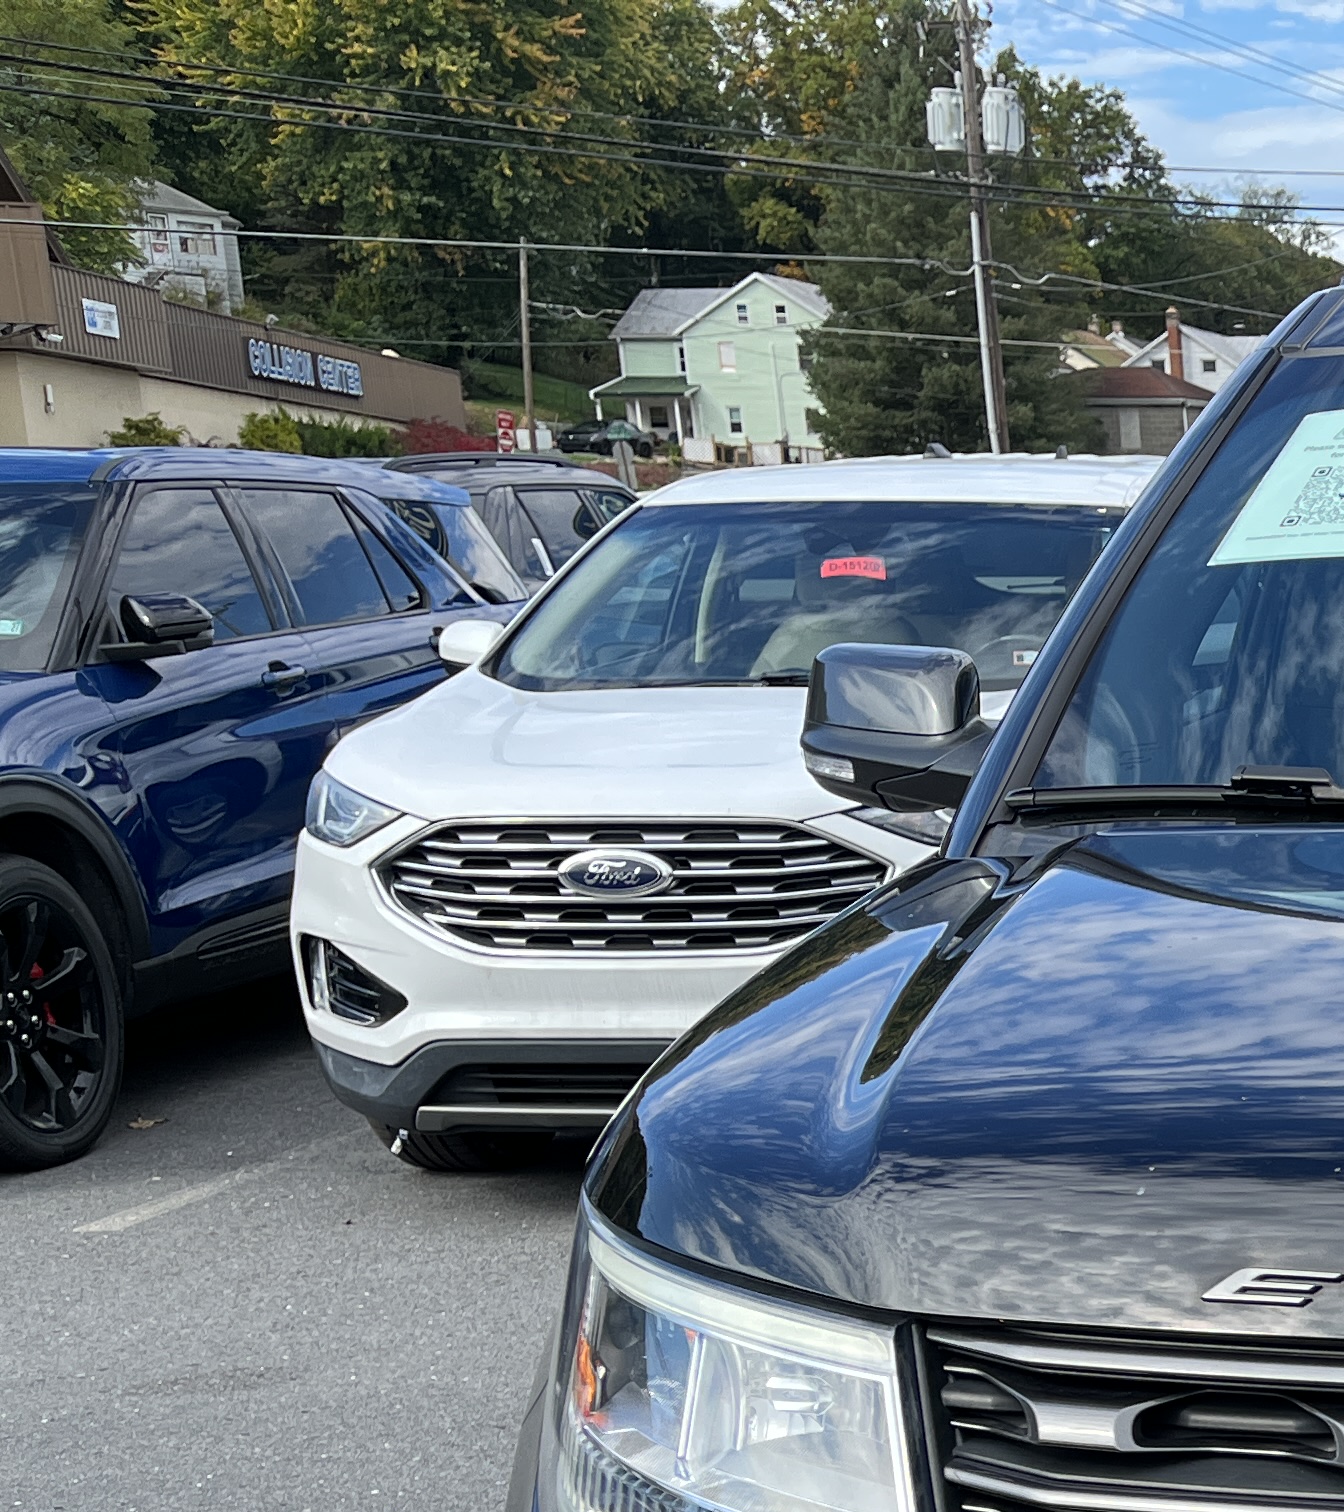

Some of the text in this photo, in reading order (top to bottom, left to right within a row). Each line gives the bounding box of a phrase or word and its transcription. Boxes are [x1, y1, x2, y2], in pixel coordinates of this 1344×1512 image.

[248, 338, 364, 396] COLLISION CENTER
[583, 860, 641, 885] Ford
